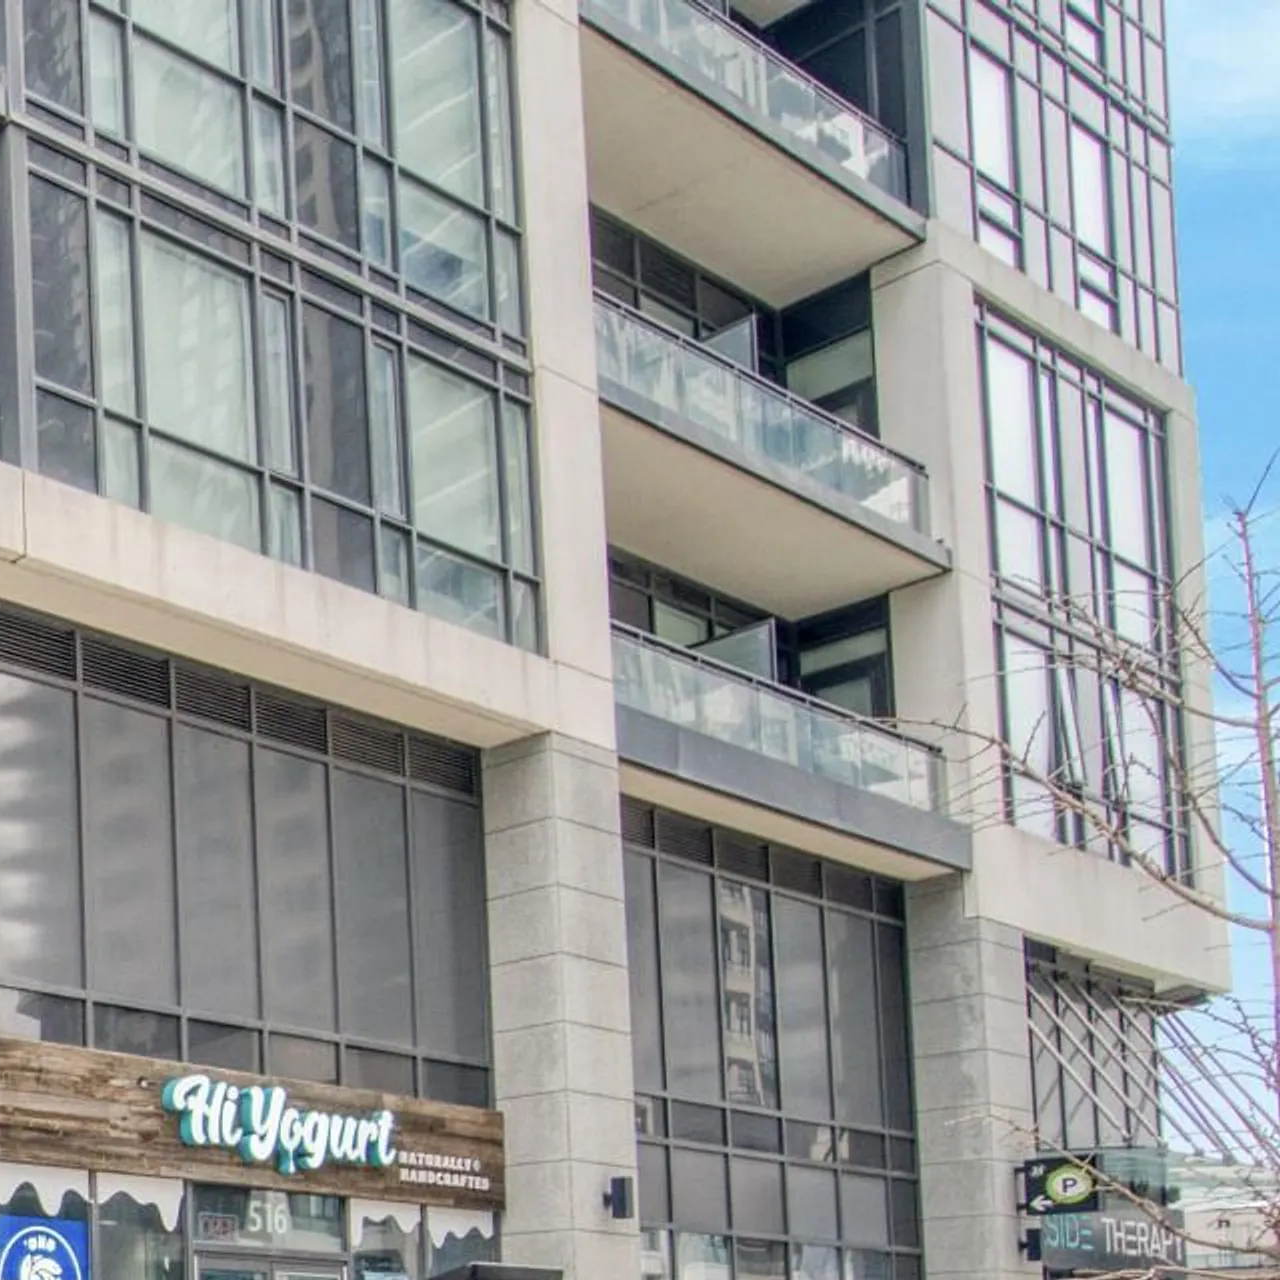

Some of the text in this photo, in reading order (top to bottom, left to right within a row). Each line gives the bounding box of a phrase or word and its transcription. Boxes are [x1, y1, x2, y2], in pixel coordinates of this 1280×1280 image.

[171, 1074, 397, 1174] Hi Yogurt
[398, 1151, 471, 1171] NATURALLY
[400, 1168, 490, 1191] HANDCRAFTED
[1061, 1178, 1077, 1193] P
[247, 1200, 288, 1234] 516
